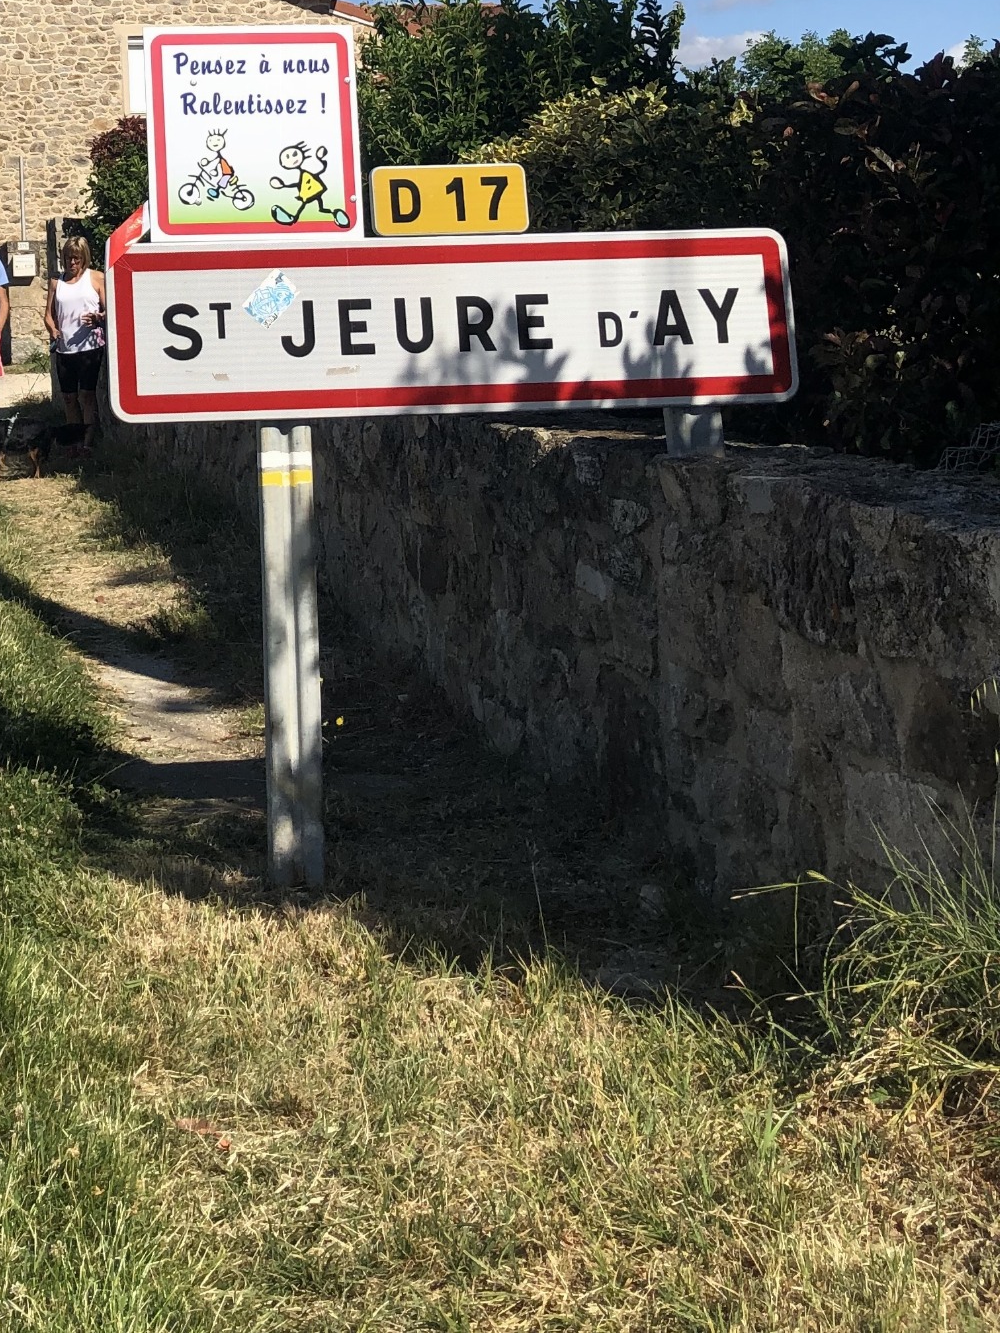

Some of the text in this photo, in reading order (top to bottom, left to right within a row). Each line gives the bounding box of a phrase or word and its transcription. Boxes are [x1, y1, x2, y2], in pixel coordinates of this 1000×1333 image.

[173, 52, 330, 75] Pensez à nous
[180, 92, 307, 115] Ralentissez
[389, 176, 508, 223] D 17
[281, 293, 553, 358] JEURE
